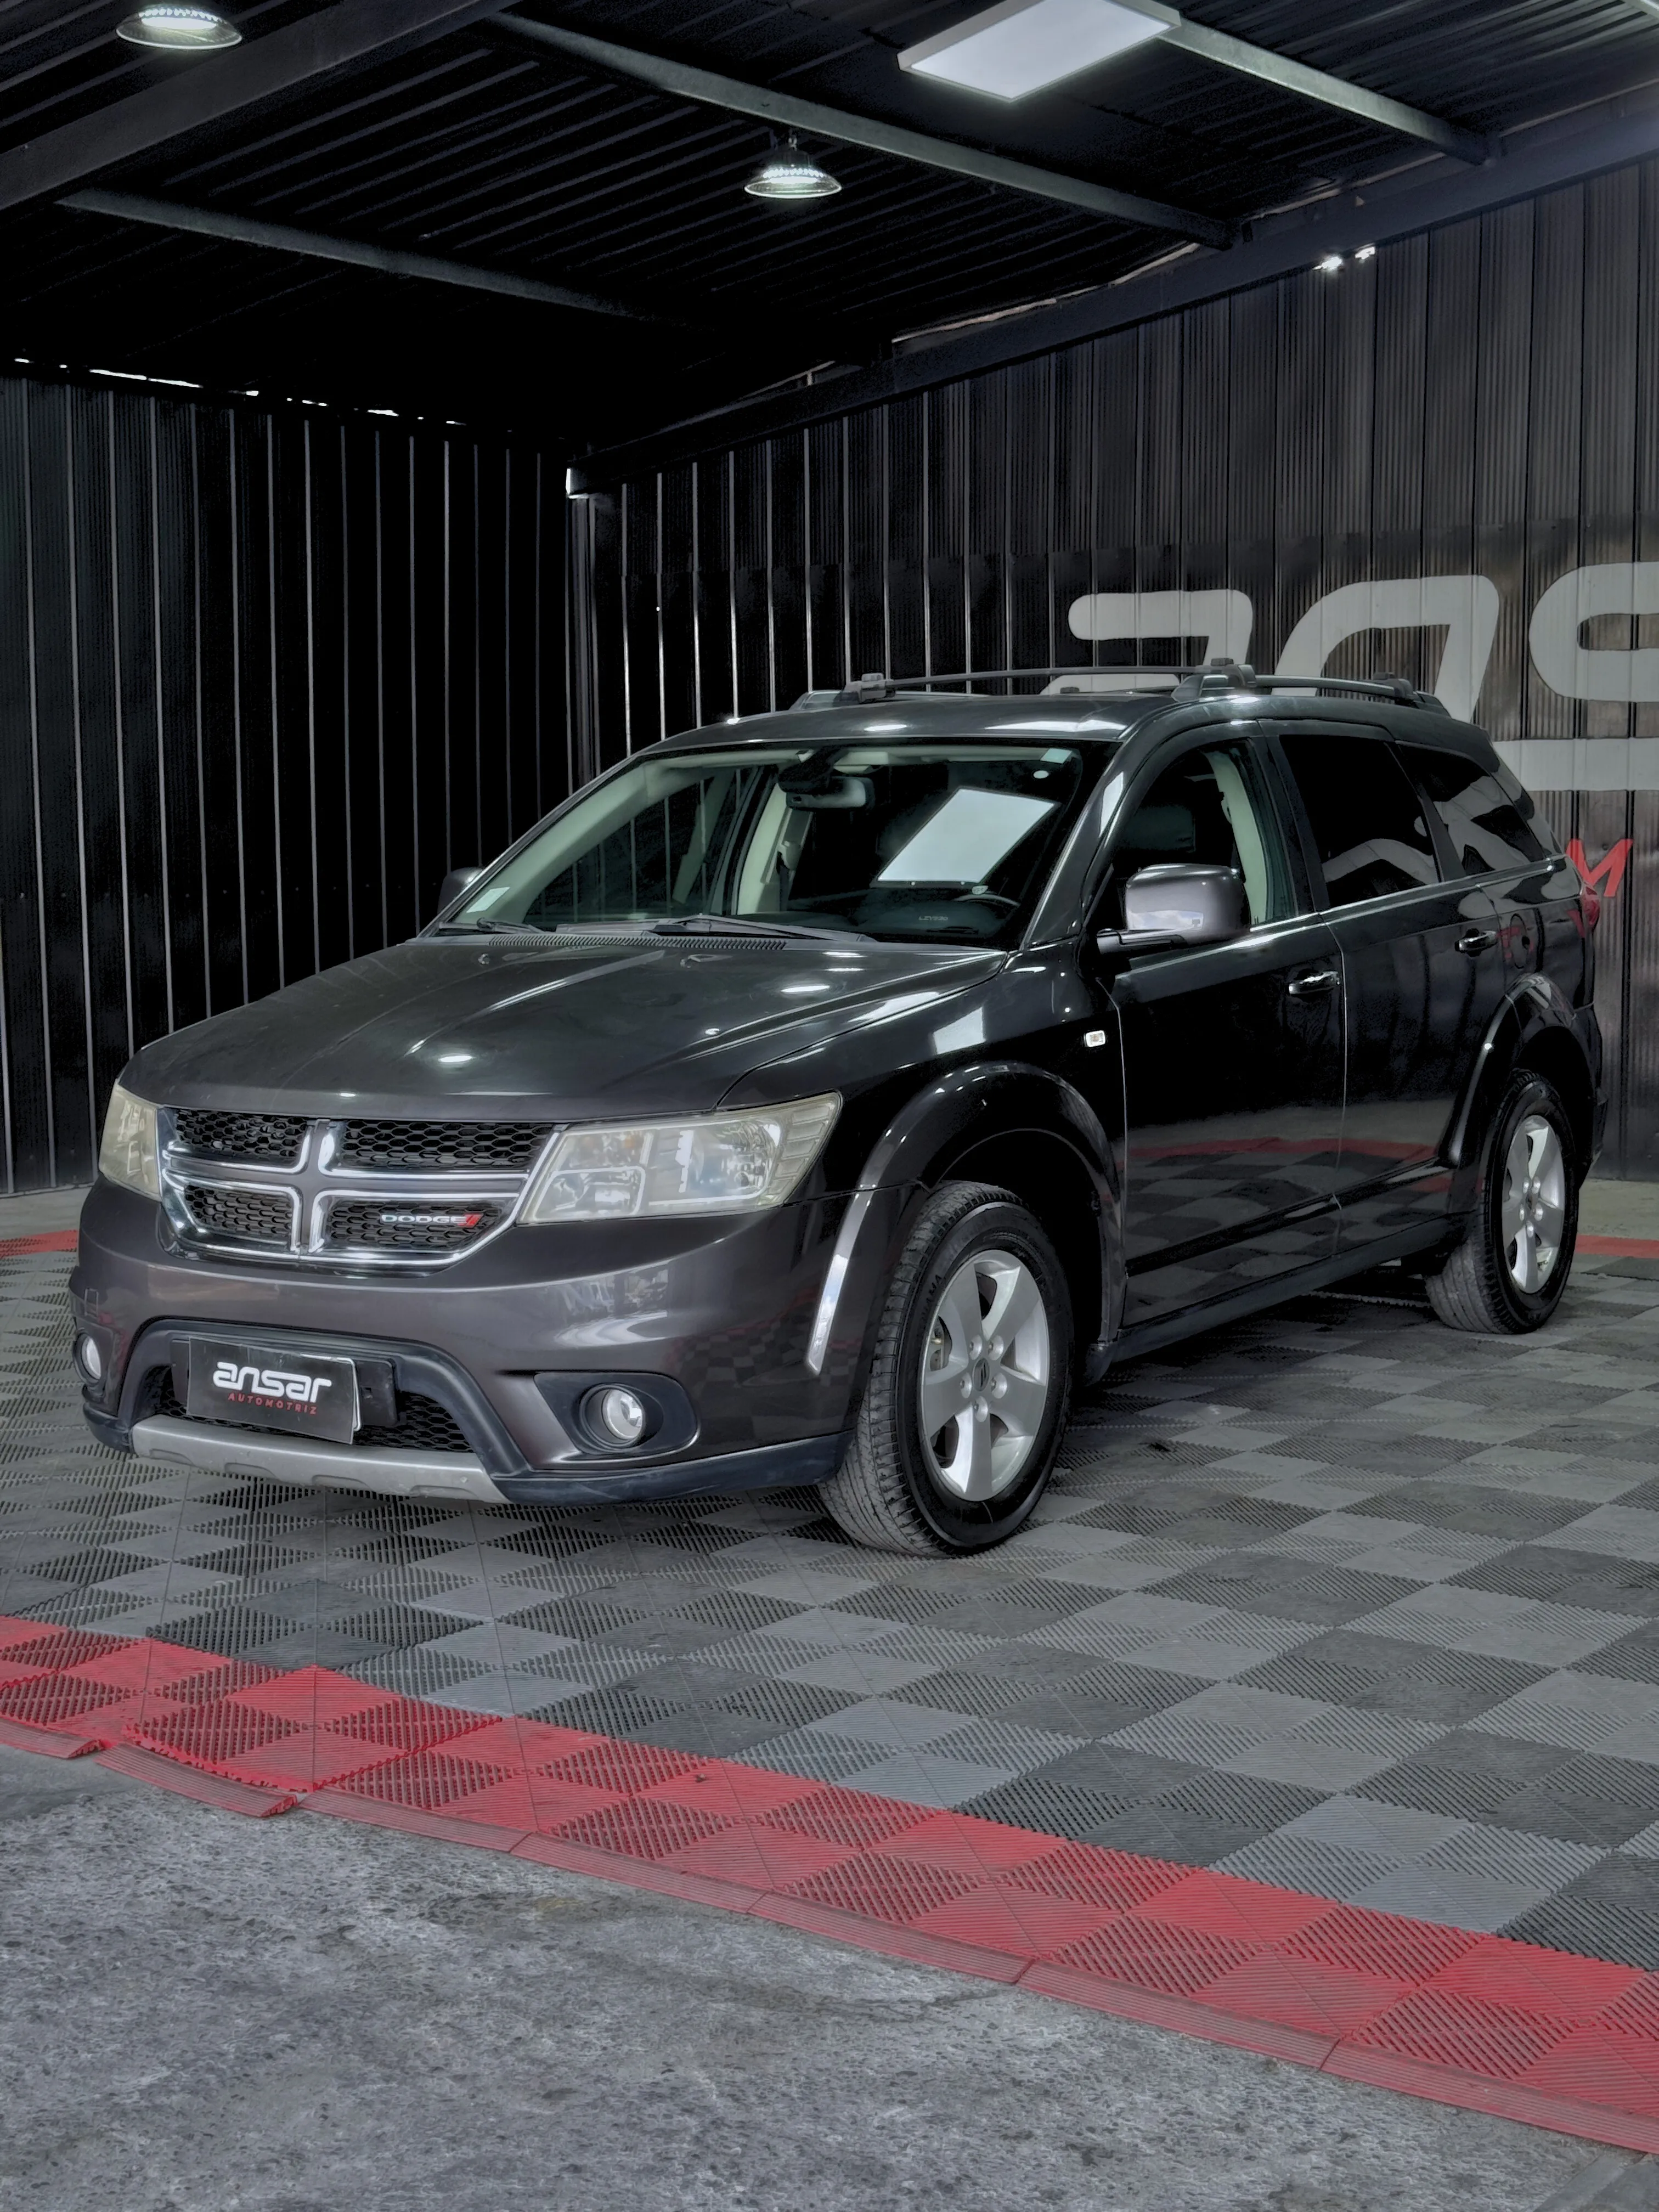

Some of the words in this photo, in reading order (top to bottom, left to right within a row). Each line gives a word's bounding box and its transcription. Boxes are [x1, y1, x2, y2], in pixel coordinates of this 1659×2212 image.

[381, 1214, 467, 1224] DODGE
[212, 1361, 332, 1403] ansar
[228, 1392, 317, 1415] AUTOMOTRIZ
